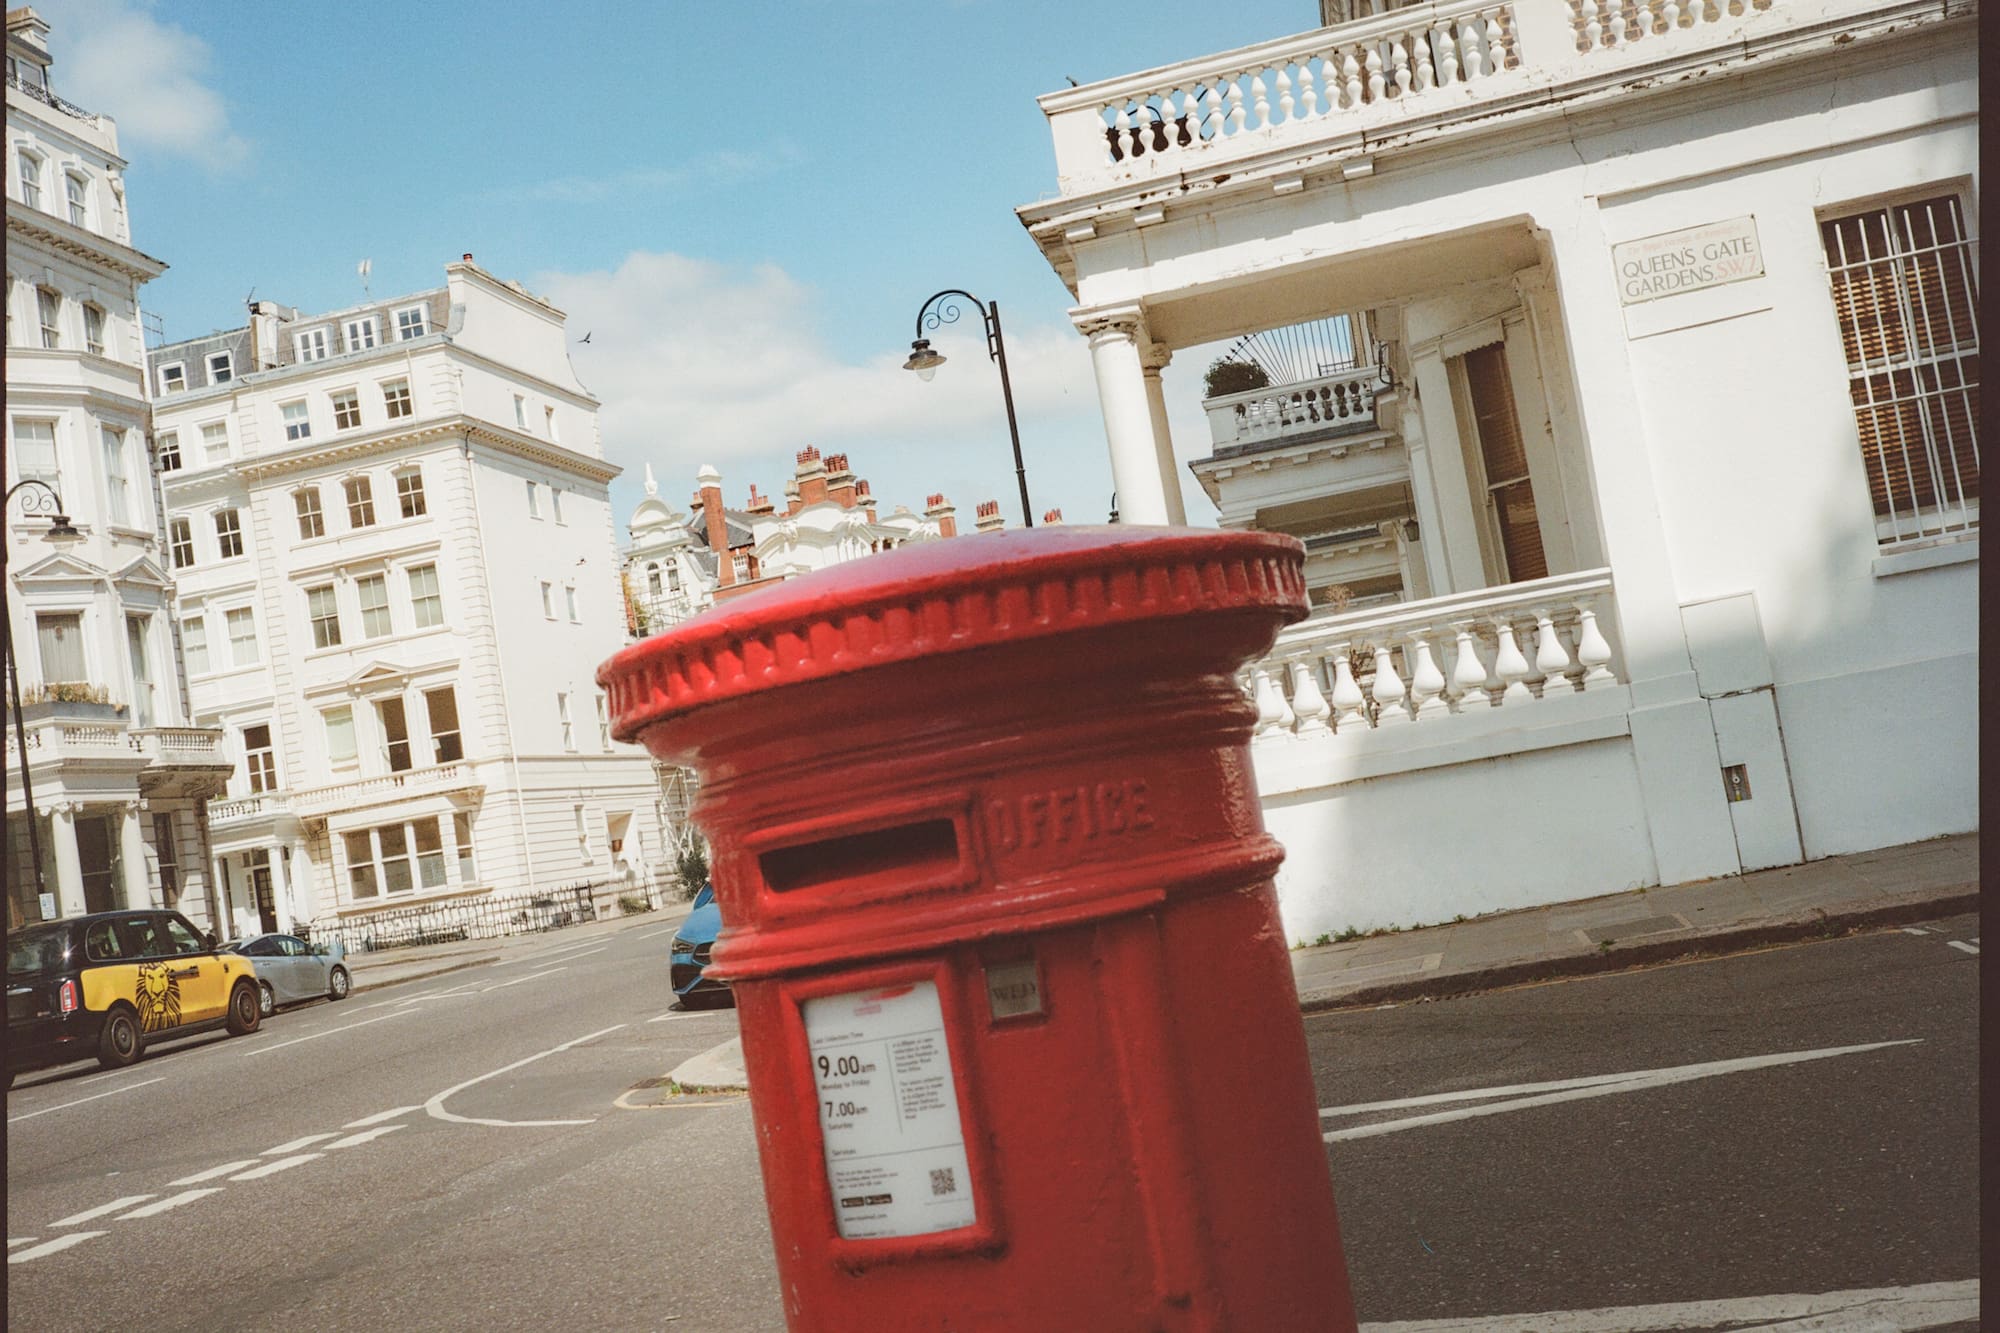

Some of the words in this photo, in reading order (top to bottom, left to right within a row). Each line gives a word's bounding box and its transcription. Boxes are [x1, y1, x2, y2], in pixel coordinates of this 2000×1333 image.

[1623, 247, 1696, 278] QUEEN'S
[1703, 237, 1753, 261] GATE
[986, 777, 1154, 851] OFFICE
[817, 1055, 877, 1078] 9.00am
[824, 1101, 868, 1118] 7.00am
